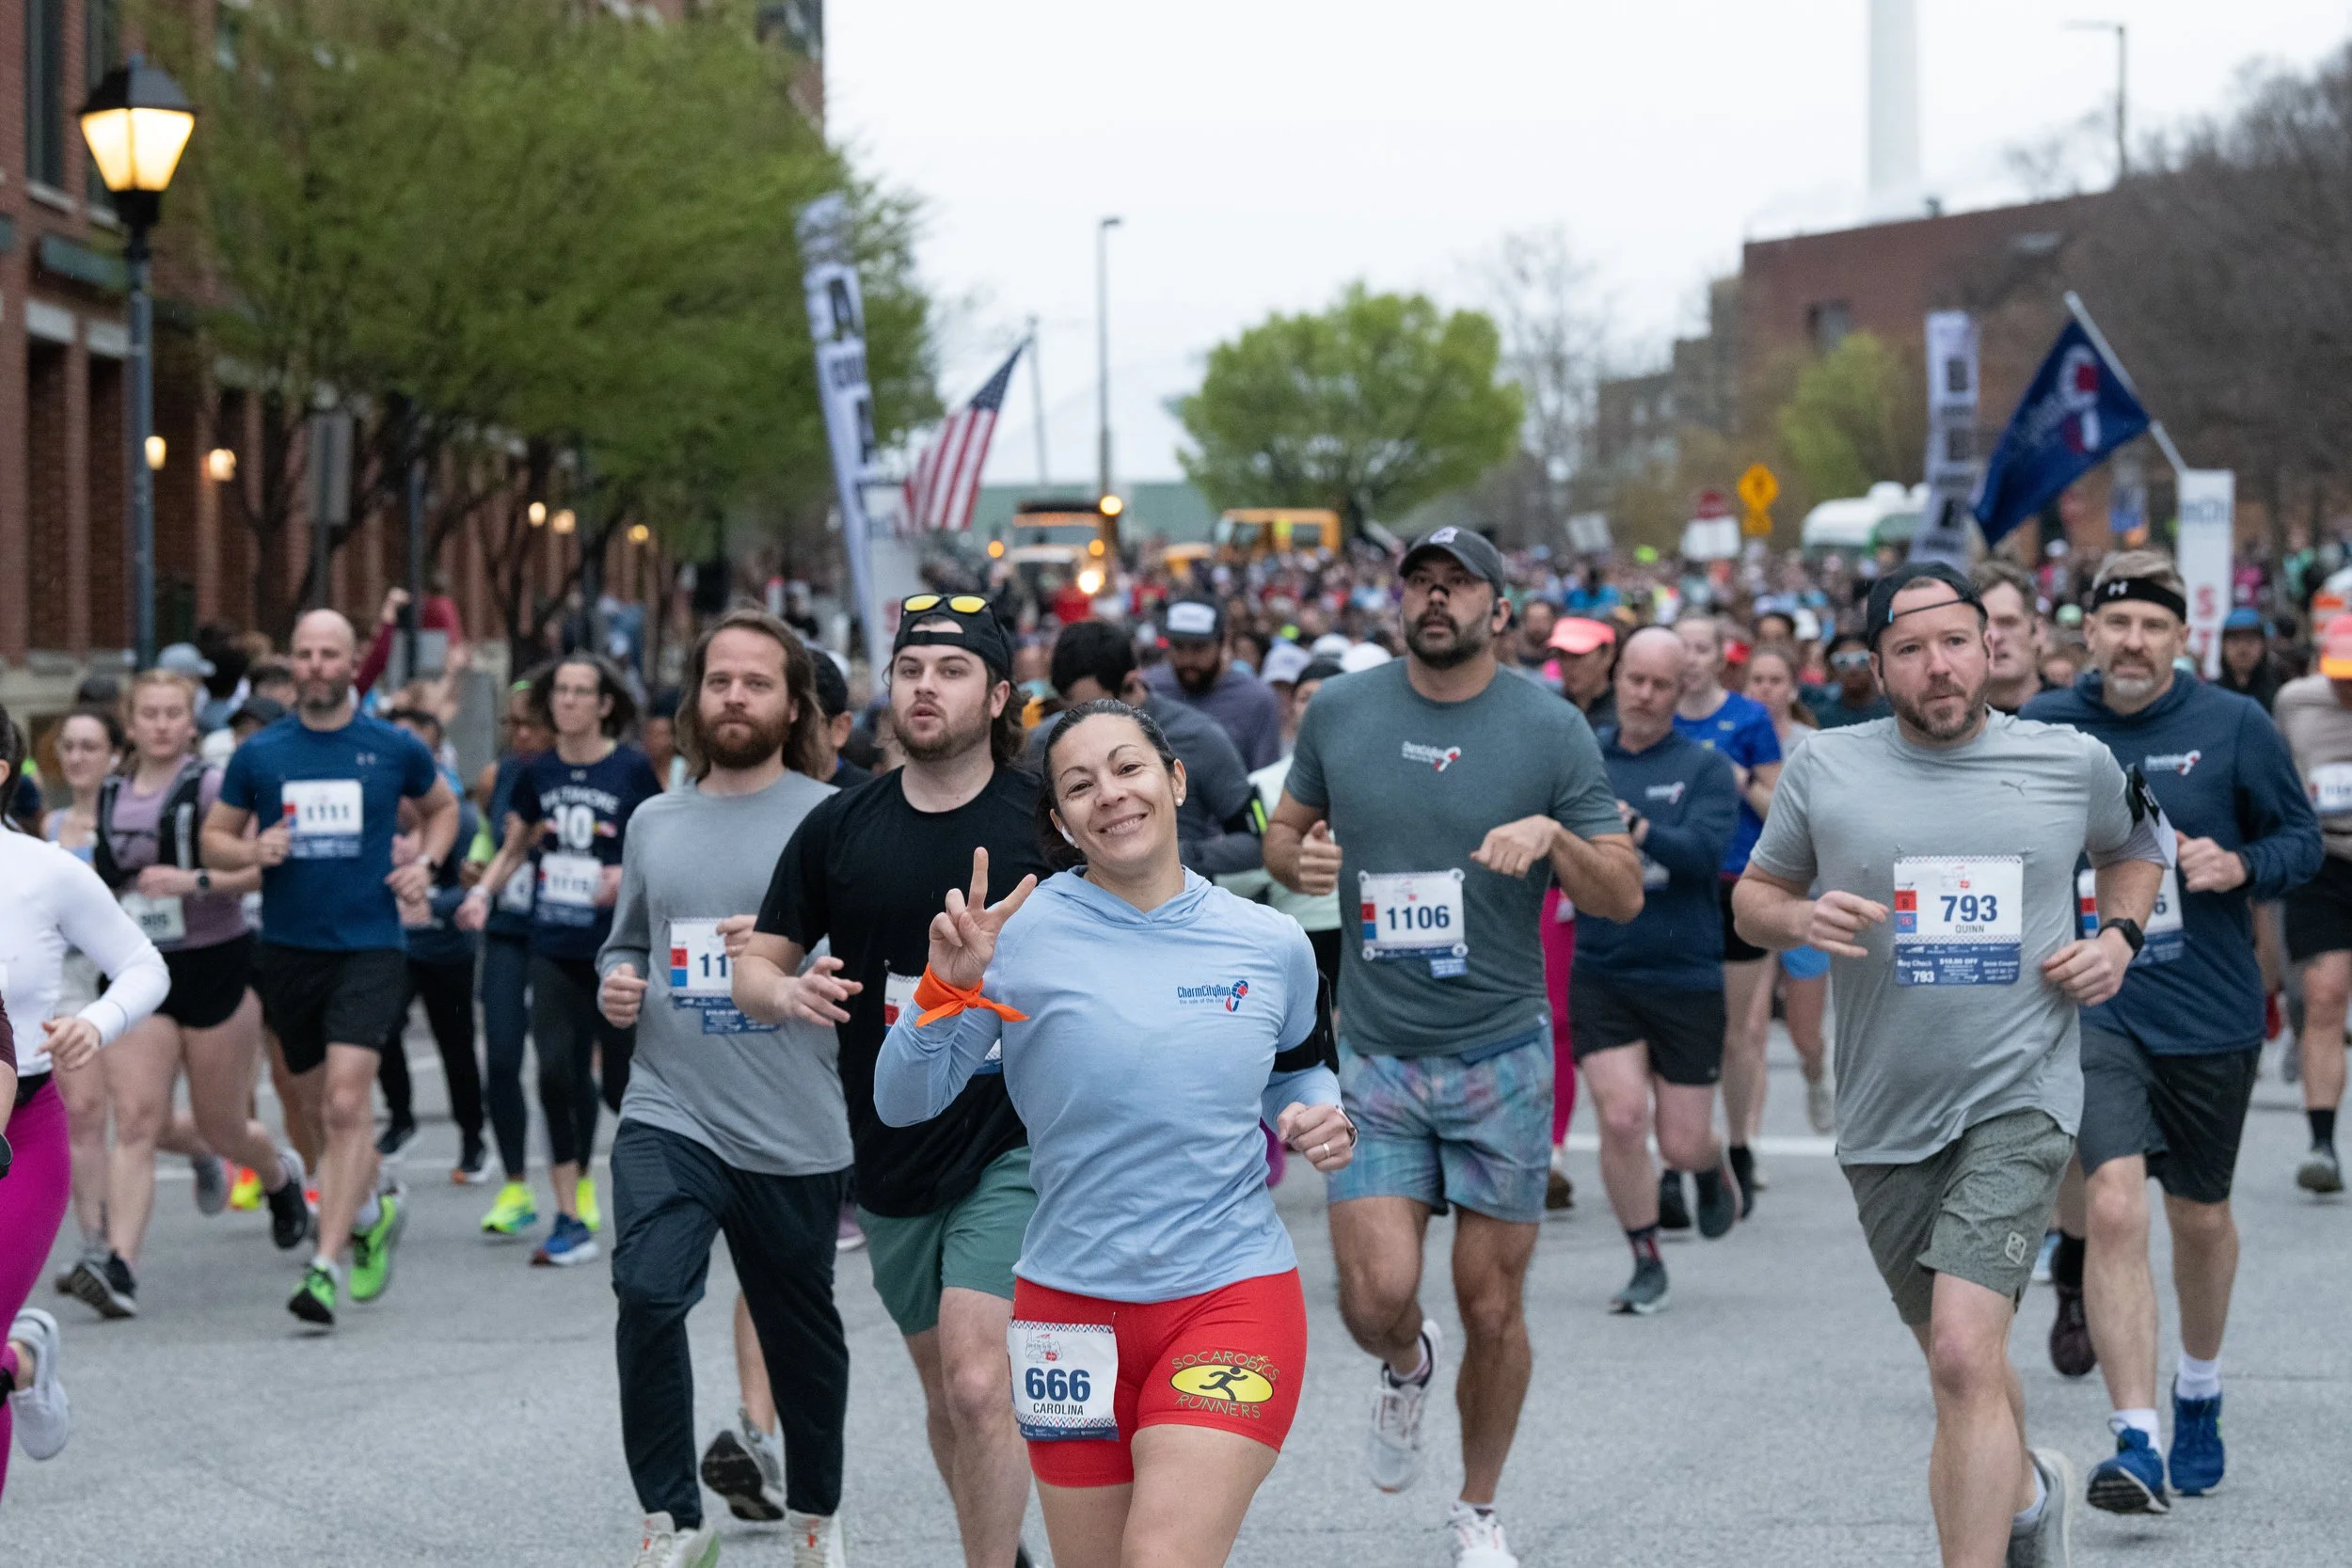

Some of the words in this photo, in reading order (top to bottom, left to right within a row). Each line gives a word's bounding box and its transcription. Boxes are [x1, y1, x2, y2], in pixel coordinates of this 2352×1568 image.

[553, 803, 596, 850] 10
[1386, 904, 1451, 930] 1106
[1940, 895, 1997, 922] 793
[1955, 924, 1984, 933] QUINN
[699, 953, 726, 977] 11
[1912, 971, 1935, 983] 793
[1177, 984, 1231, 998] CharmCityRun
[1025, 1367, 1091, 1402] 666
[1033, 1402, 1084, 1416] CAROLINA
[1174, 1394, 1261, 1418] RUNNERS
